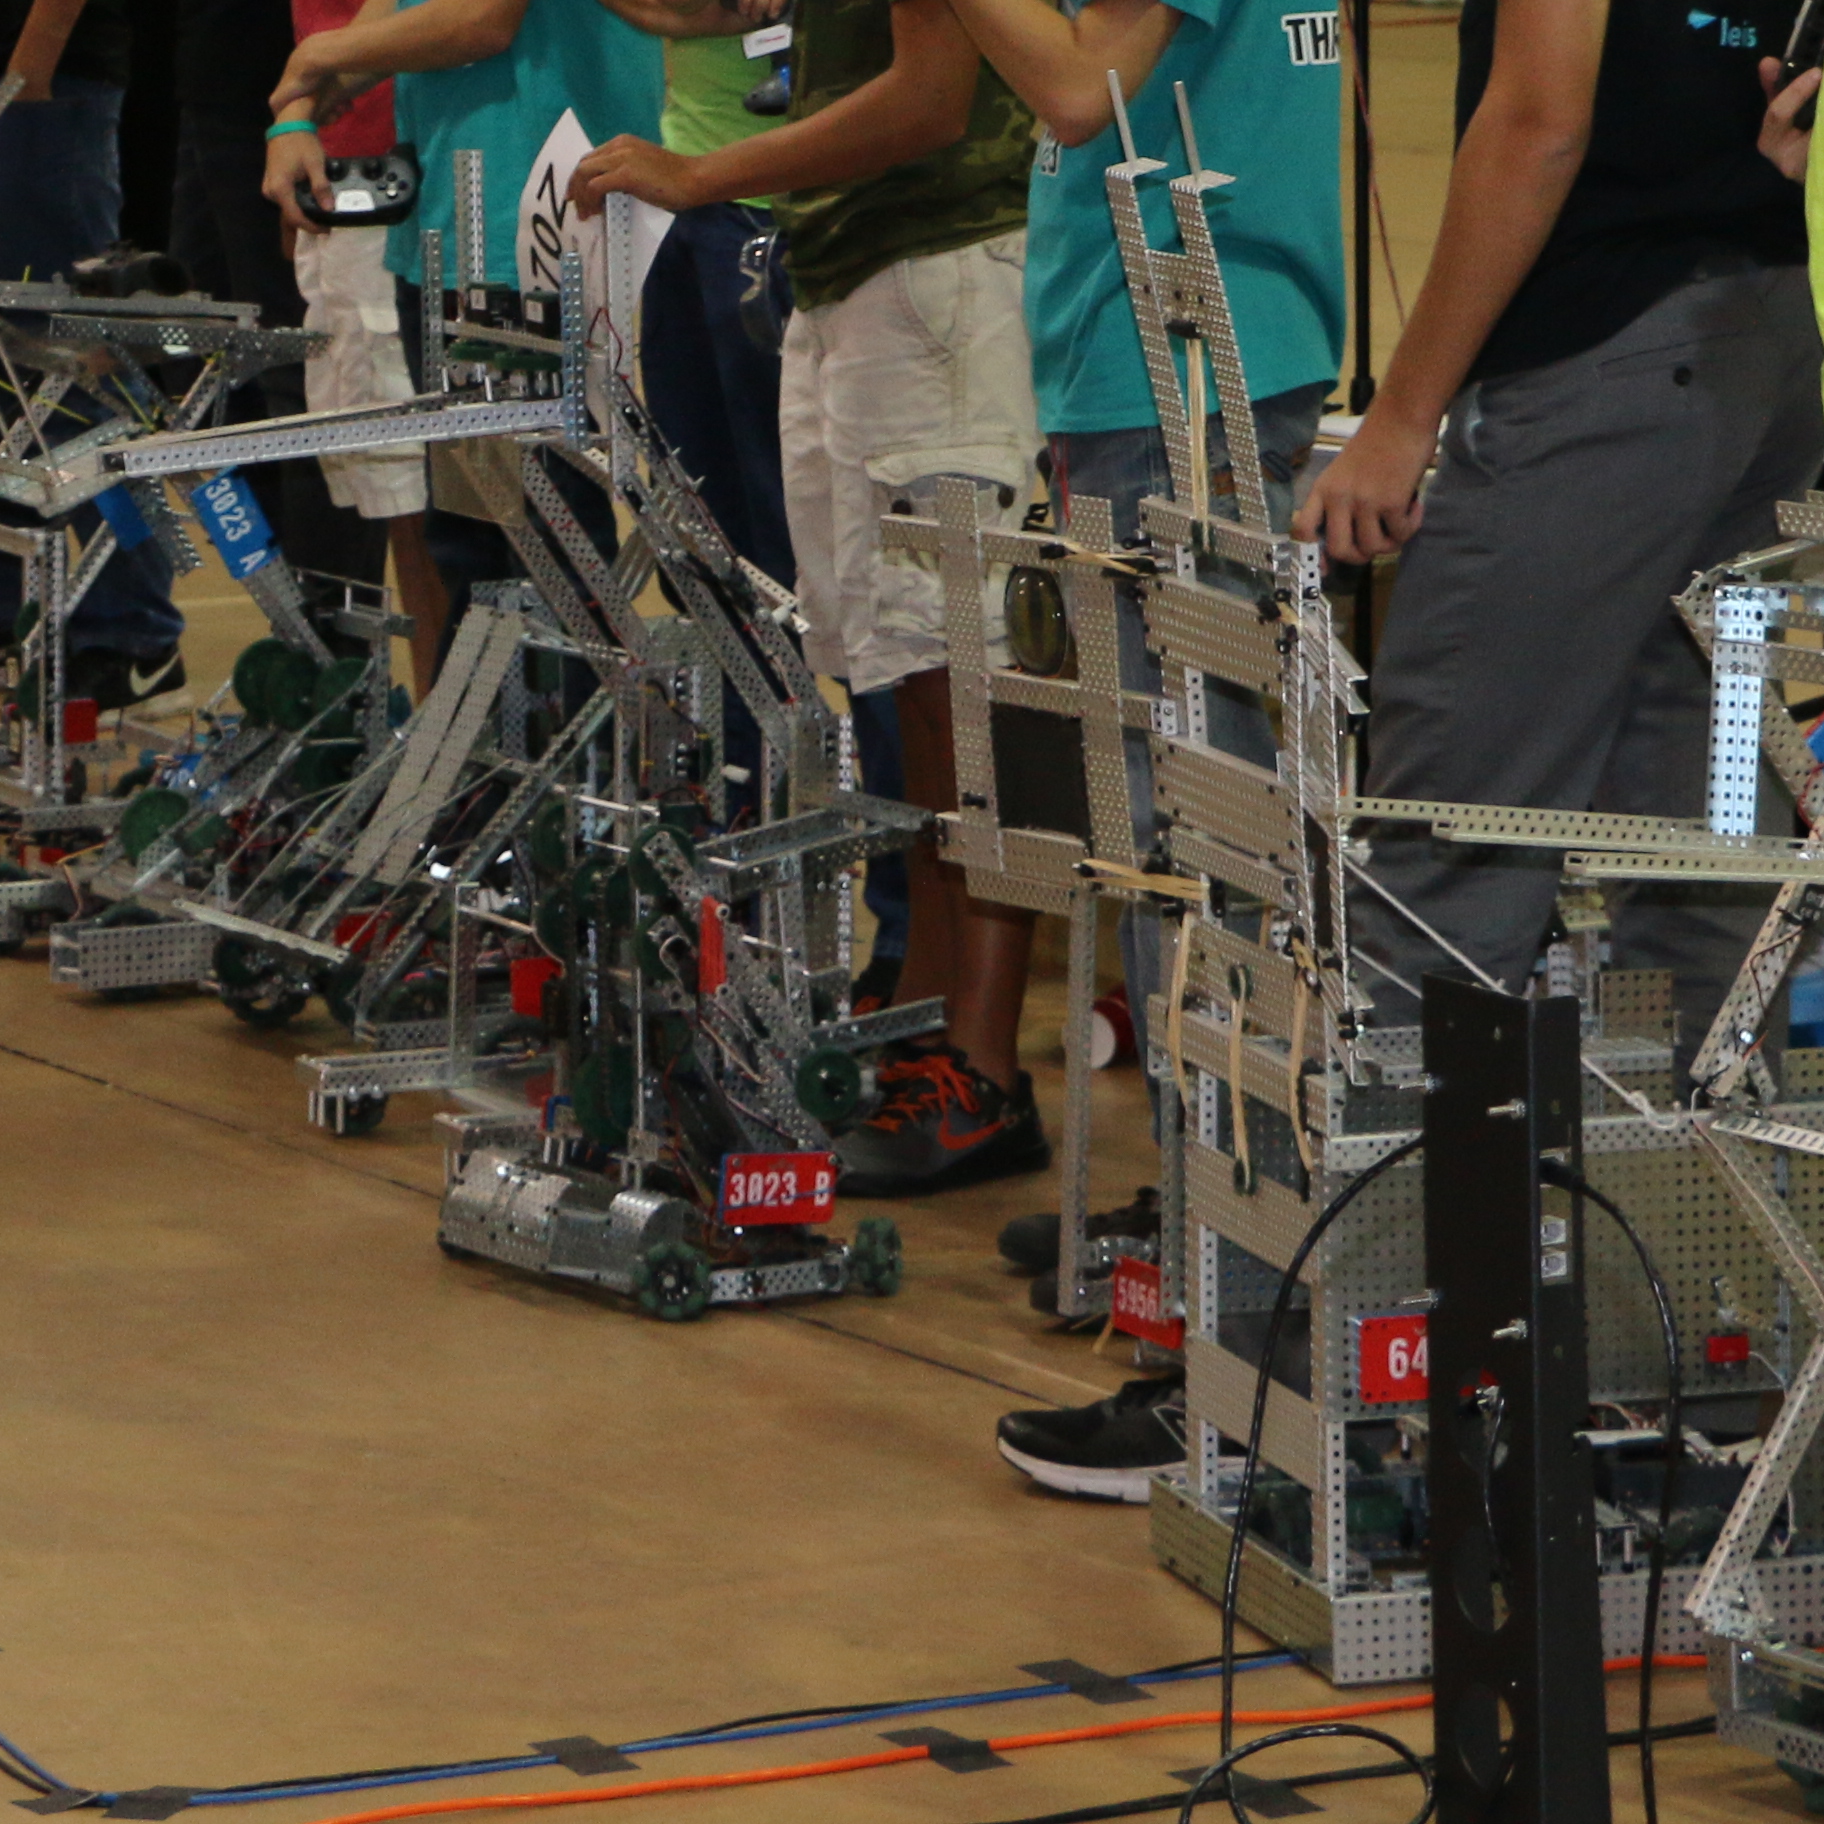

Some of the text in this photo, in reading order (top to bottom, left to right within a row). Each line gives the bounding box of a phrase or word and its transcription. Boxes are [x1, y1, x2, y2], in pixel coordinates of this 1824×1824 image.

[529, 162, 568, 293] 70Z
[205, 478, 268, 573] 3023 A
[728, 1170, 831, 1207] 3023 B
